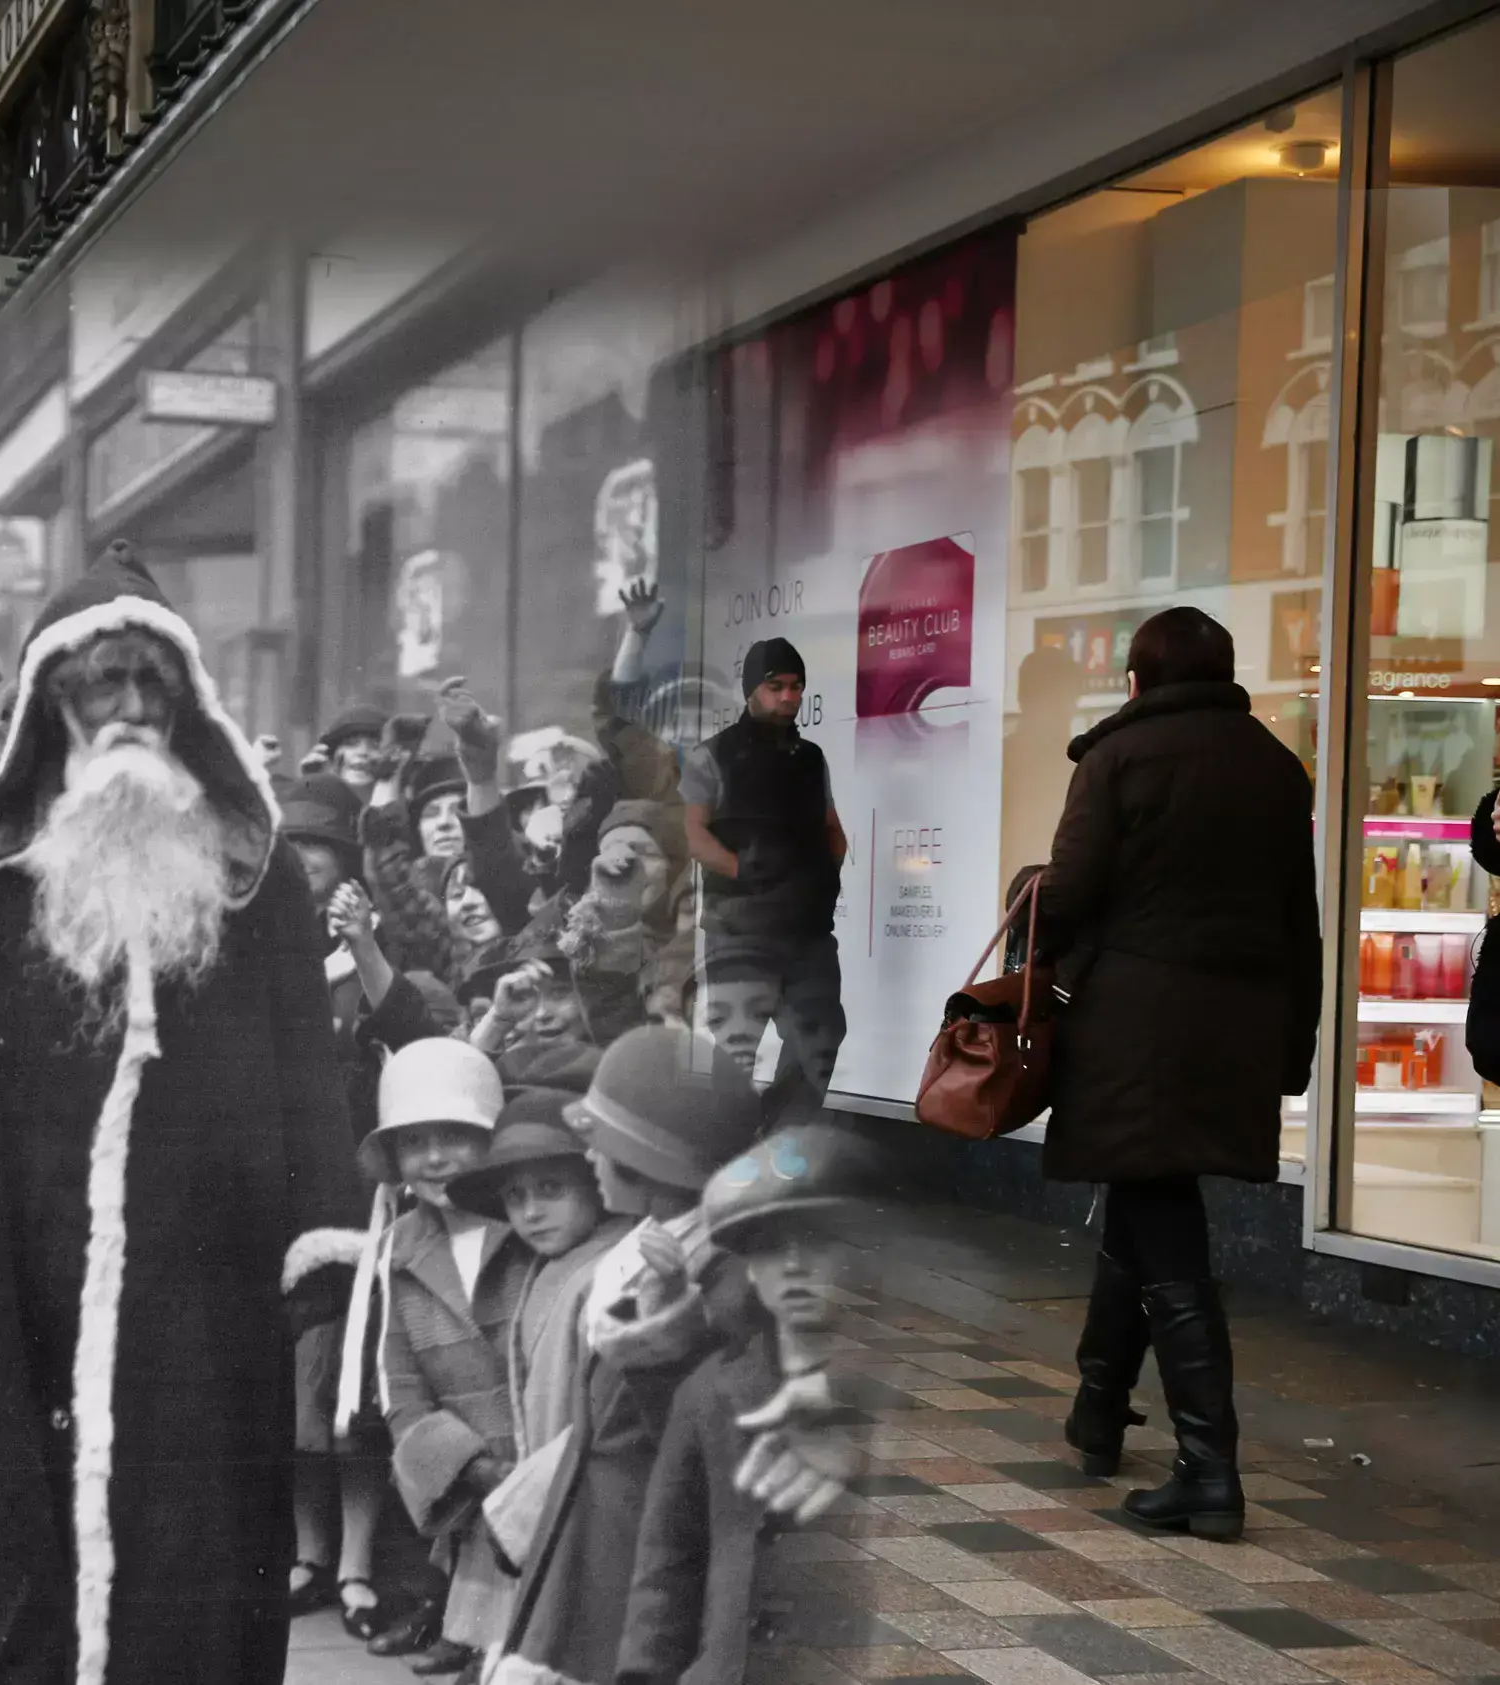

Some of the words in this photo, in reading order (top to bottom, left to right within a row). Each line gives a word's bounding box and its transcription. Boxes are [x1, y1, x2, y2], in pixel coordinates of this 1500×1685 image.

[724, 589, 762, 628] JOIN
[767, 580, 805, 618] OUR
[868, 617, 920, 647] BEAUTY
[924, 608, 960, 637] CLUB
[894, 827, 943, 865] FREE
